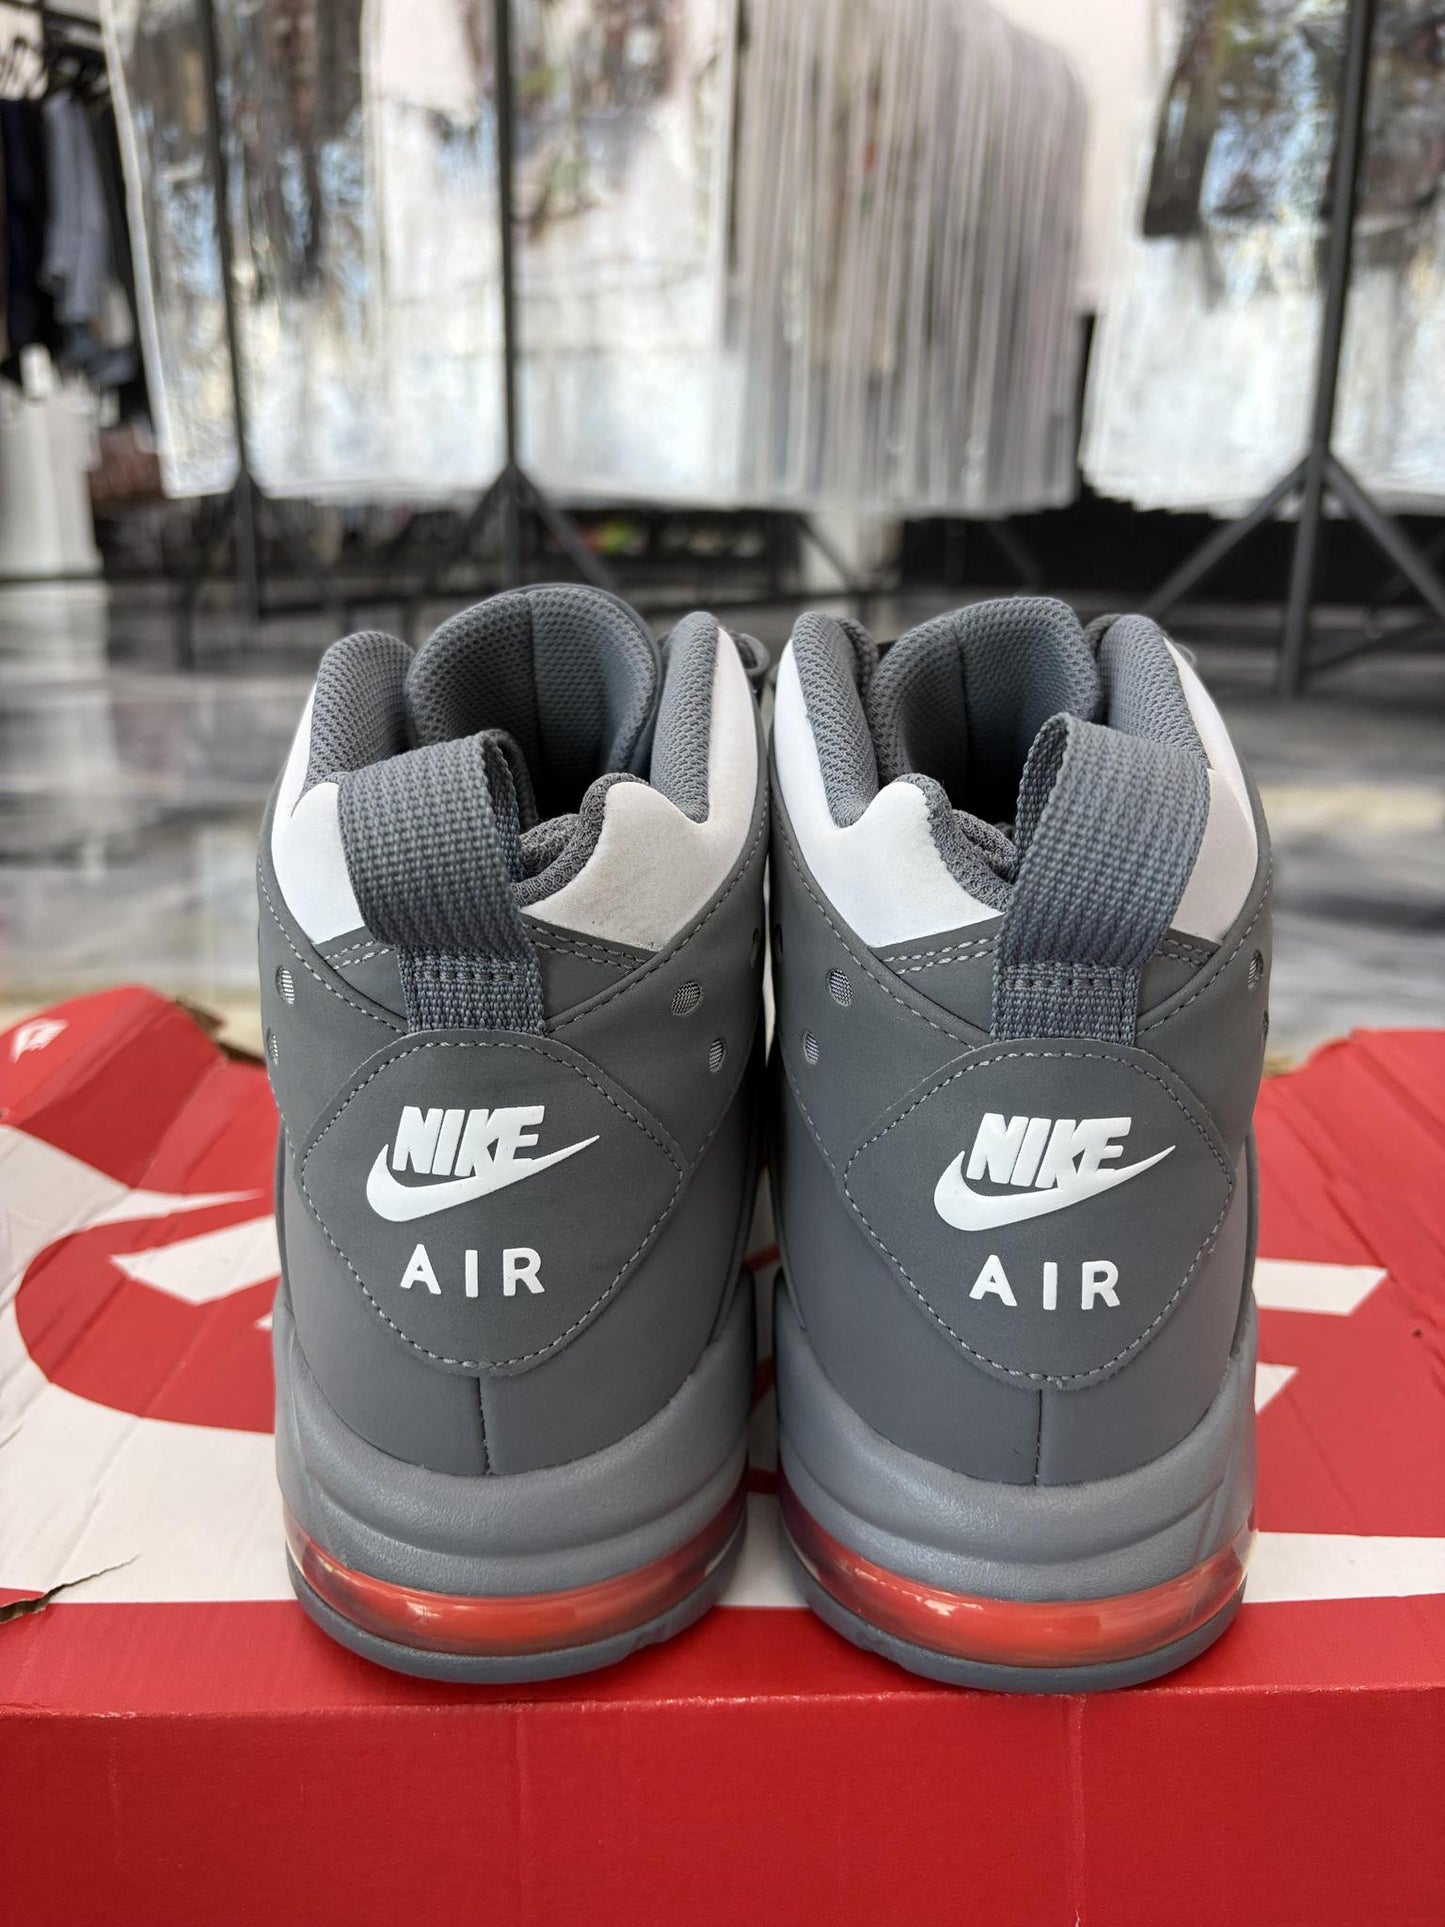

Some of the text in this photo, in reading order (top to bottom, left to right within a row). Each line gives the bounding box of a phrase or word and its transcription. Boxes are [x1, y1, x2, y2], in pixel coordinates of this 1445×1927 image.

[392, 1105, 545, 1177] NIKE
[966, 1112, 1132, 1189] NIKE
[400, 1243, 545, 1298] AIR
[969, 1254, 1121, 1311] AIR
